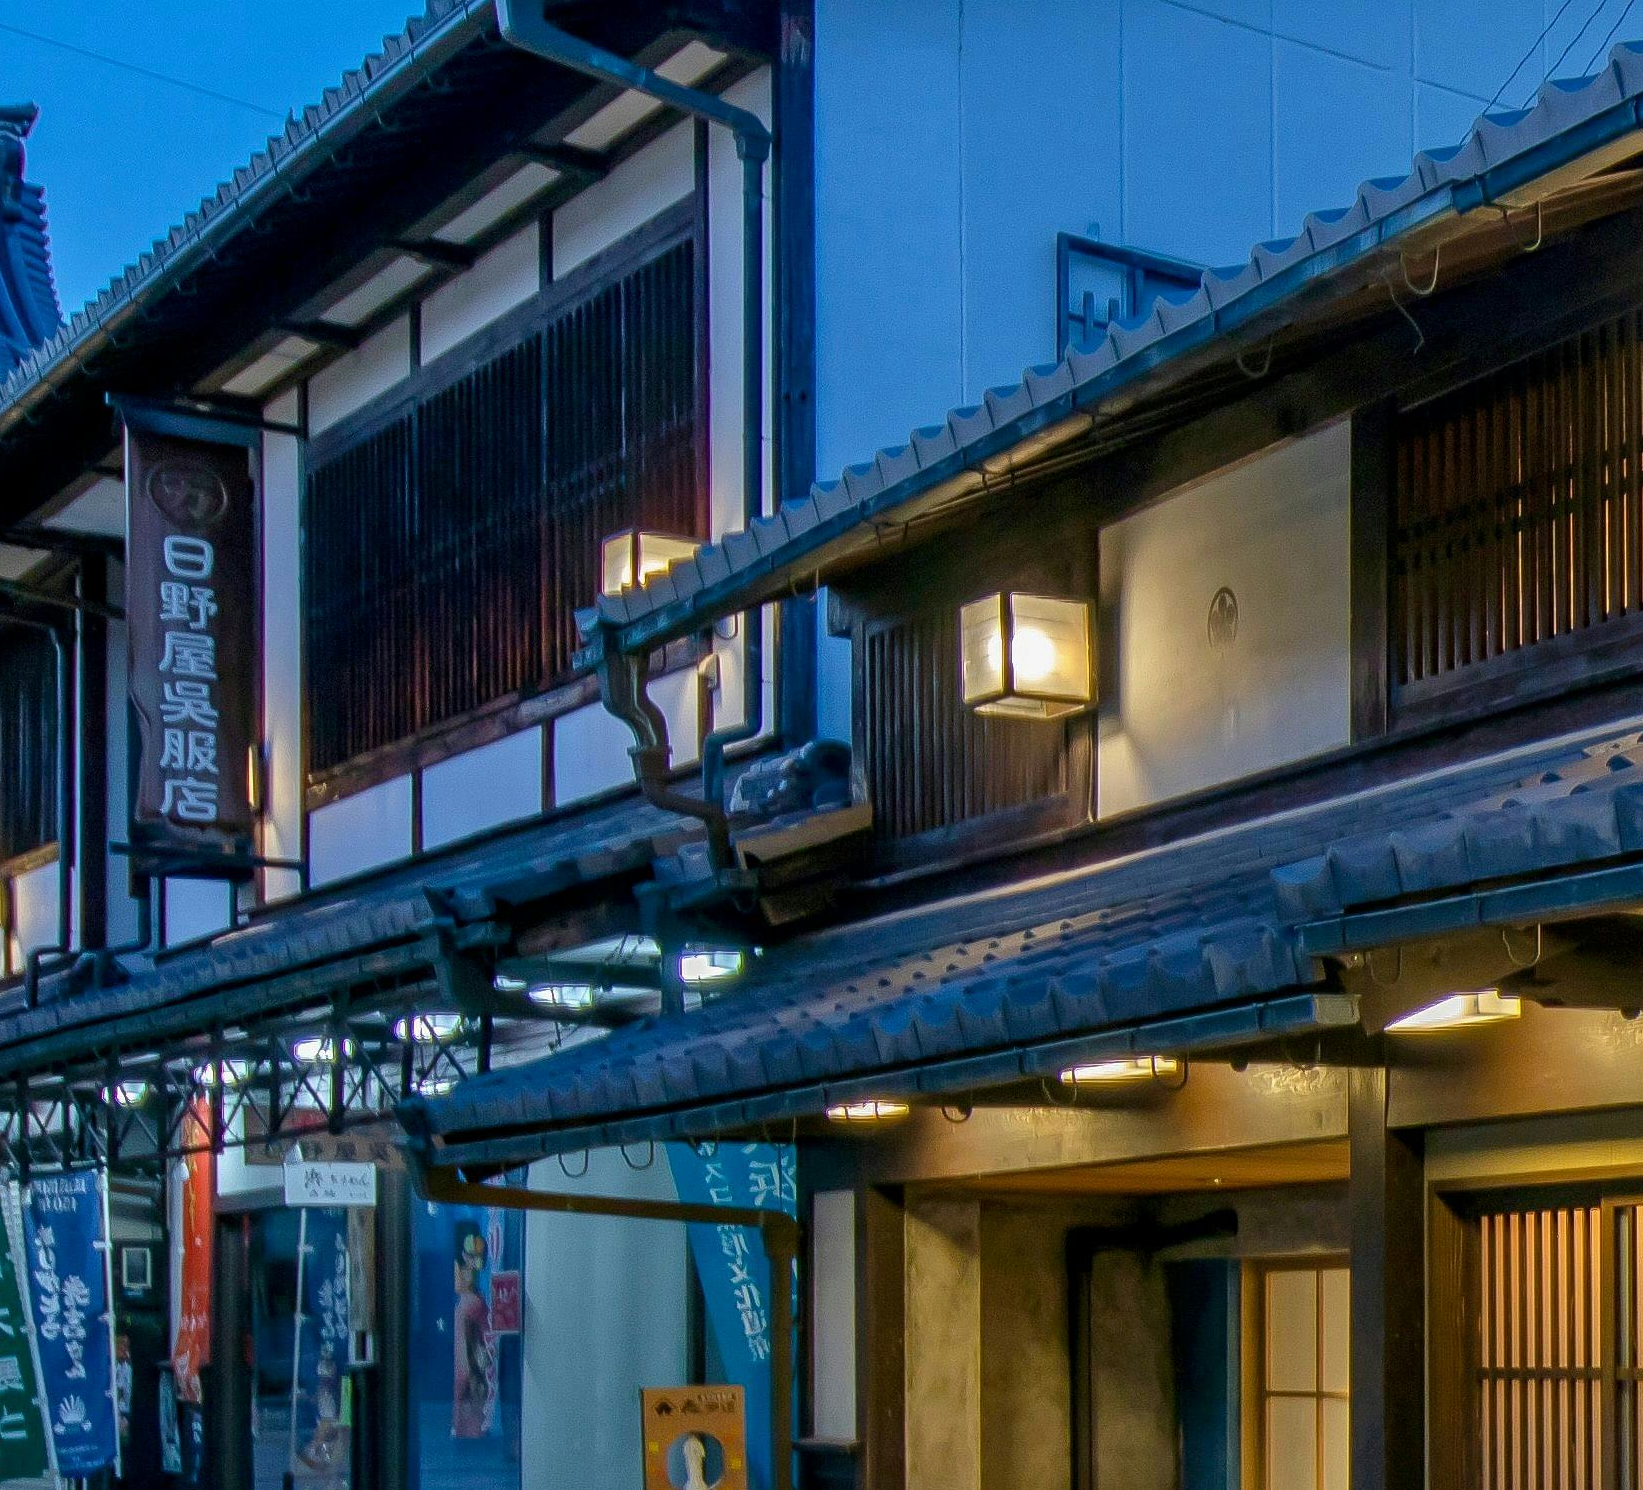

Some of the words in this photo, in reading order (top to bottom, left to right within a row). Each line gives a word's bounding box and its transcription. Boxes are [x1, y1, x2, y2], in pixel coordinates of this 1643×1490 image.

[159, 534, 219, 823] 日野屋呉服店
